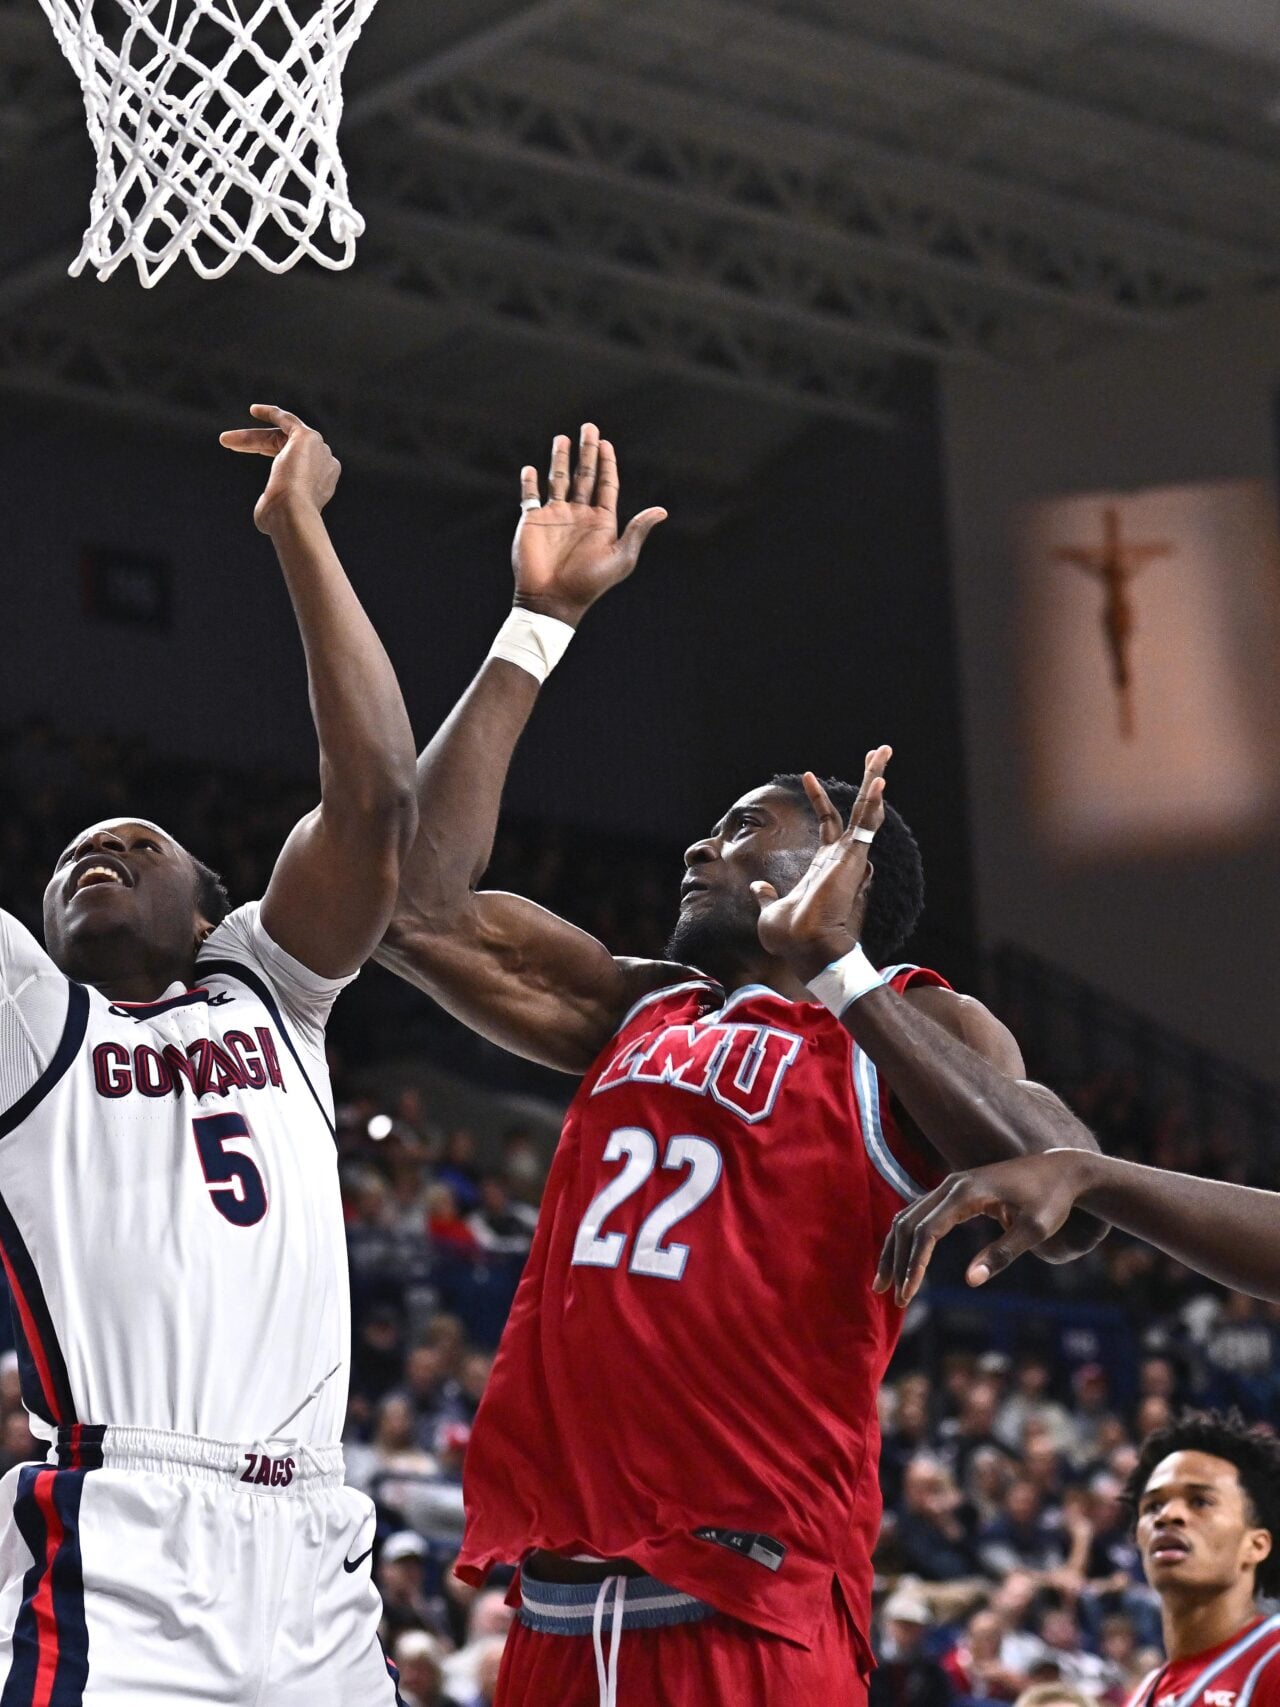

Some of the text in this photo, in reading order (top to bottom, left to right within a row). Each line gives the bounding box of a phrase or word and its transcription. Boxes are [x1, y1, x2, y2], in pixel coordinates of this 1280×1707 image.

[590, 1022, 803, 1124] LMU
[192, 1112, 268, 1227] 5
[571, 1125, 723, 1281] 22
[240, 1453, 296, 1487] ZAGS
